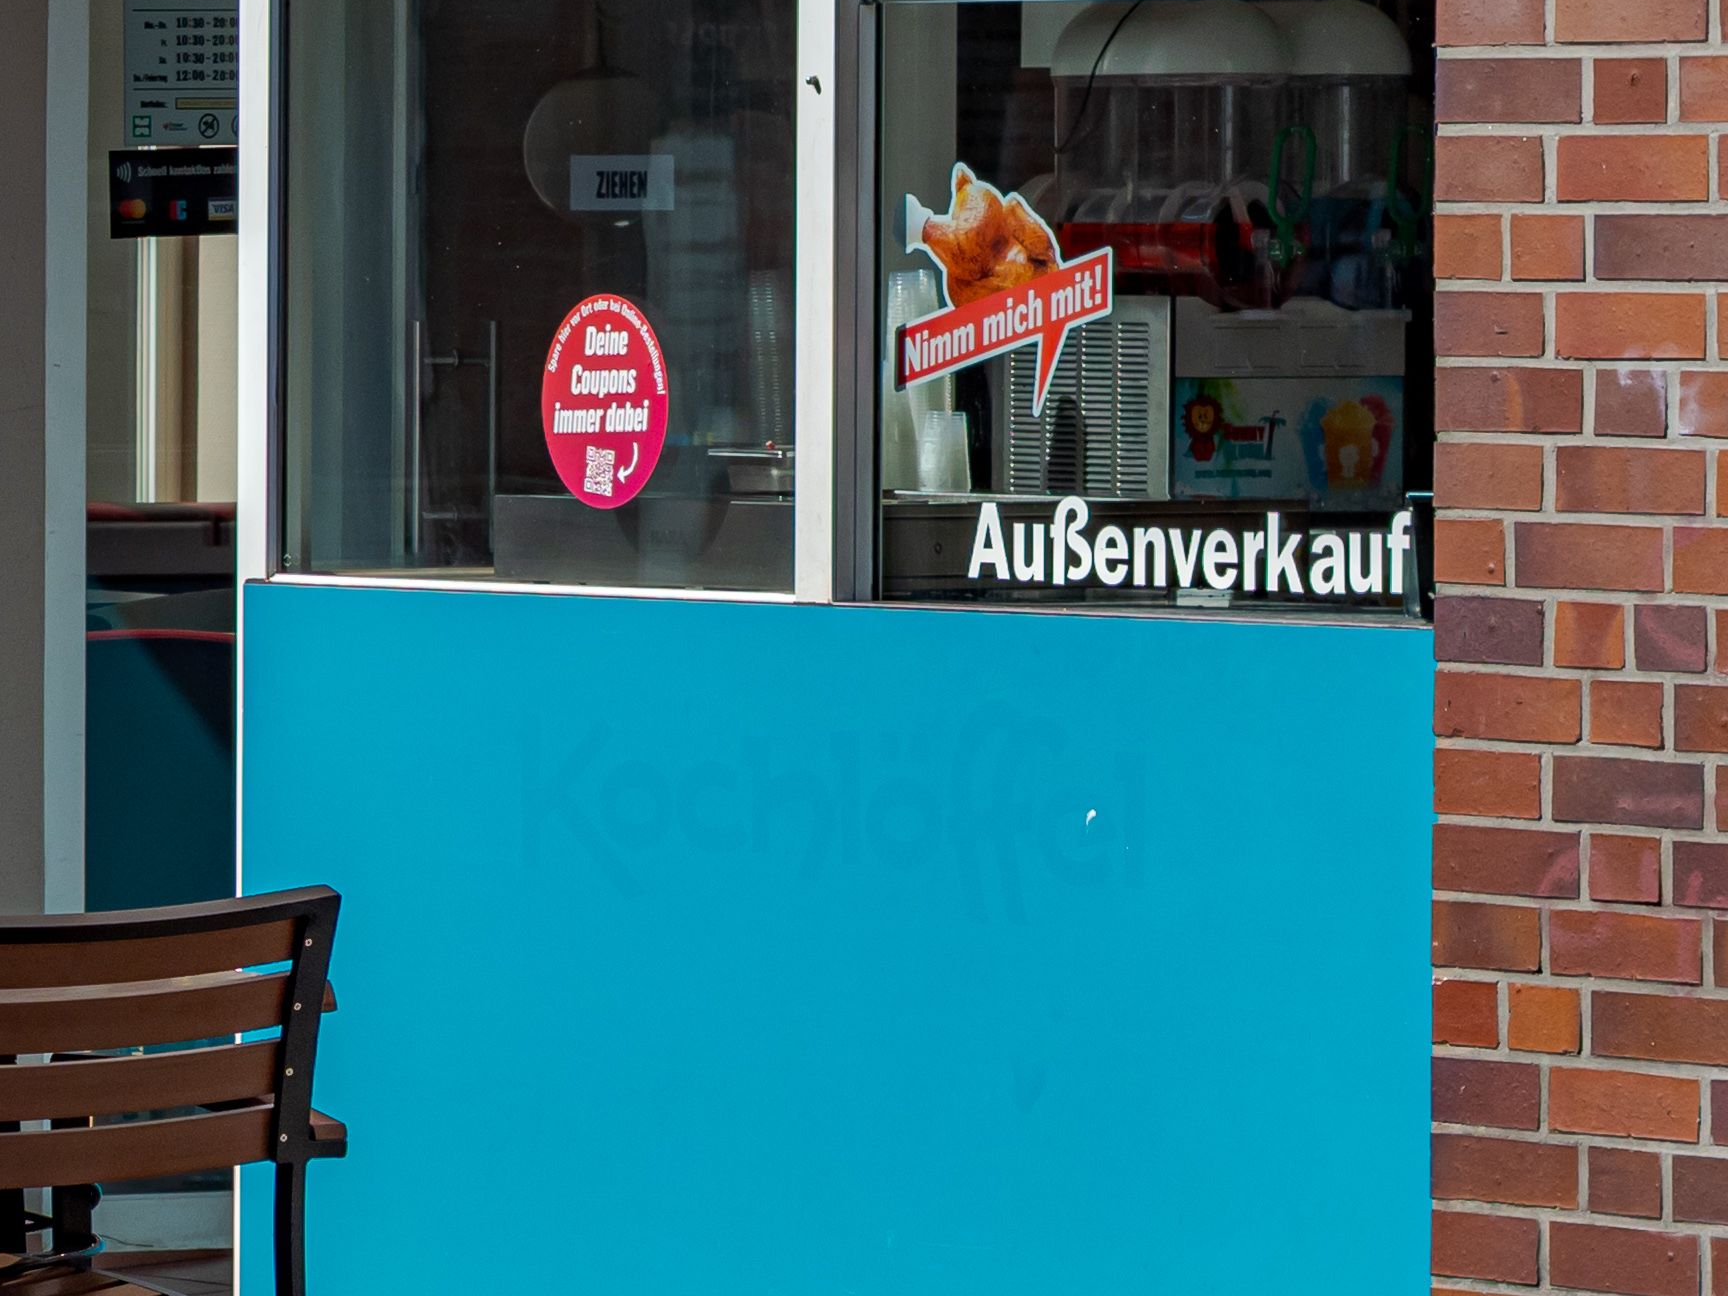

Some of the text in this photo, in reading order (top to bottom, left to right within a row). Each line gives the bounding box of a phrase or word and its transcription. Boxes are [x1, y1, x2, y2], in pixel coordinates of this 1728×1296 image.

[596, 170, 648, 199] ZIEHEN
[904, 264, 1102, 376] Nimm mich mit!
[547, 298, 667, 395] Spare hier vor Ort oder bei Online-Bestellungen!
[584, 323, 629, 356] Deine
[571, 364, 637, 398] Coupons
[553, 400, 649, 434] immer dabei
[968, 494, 1412, 595] Außenverkauf
